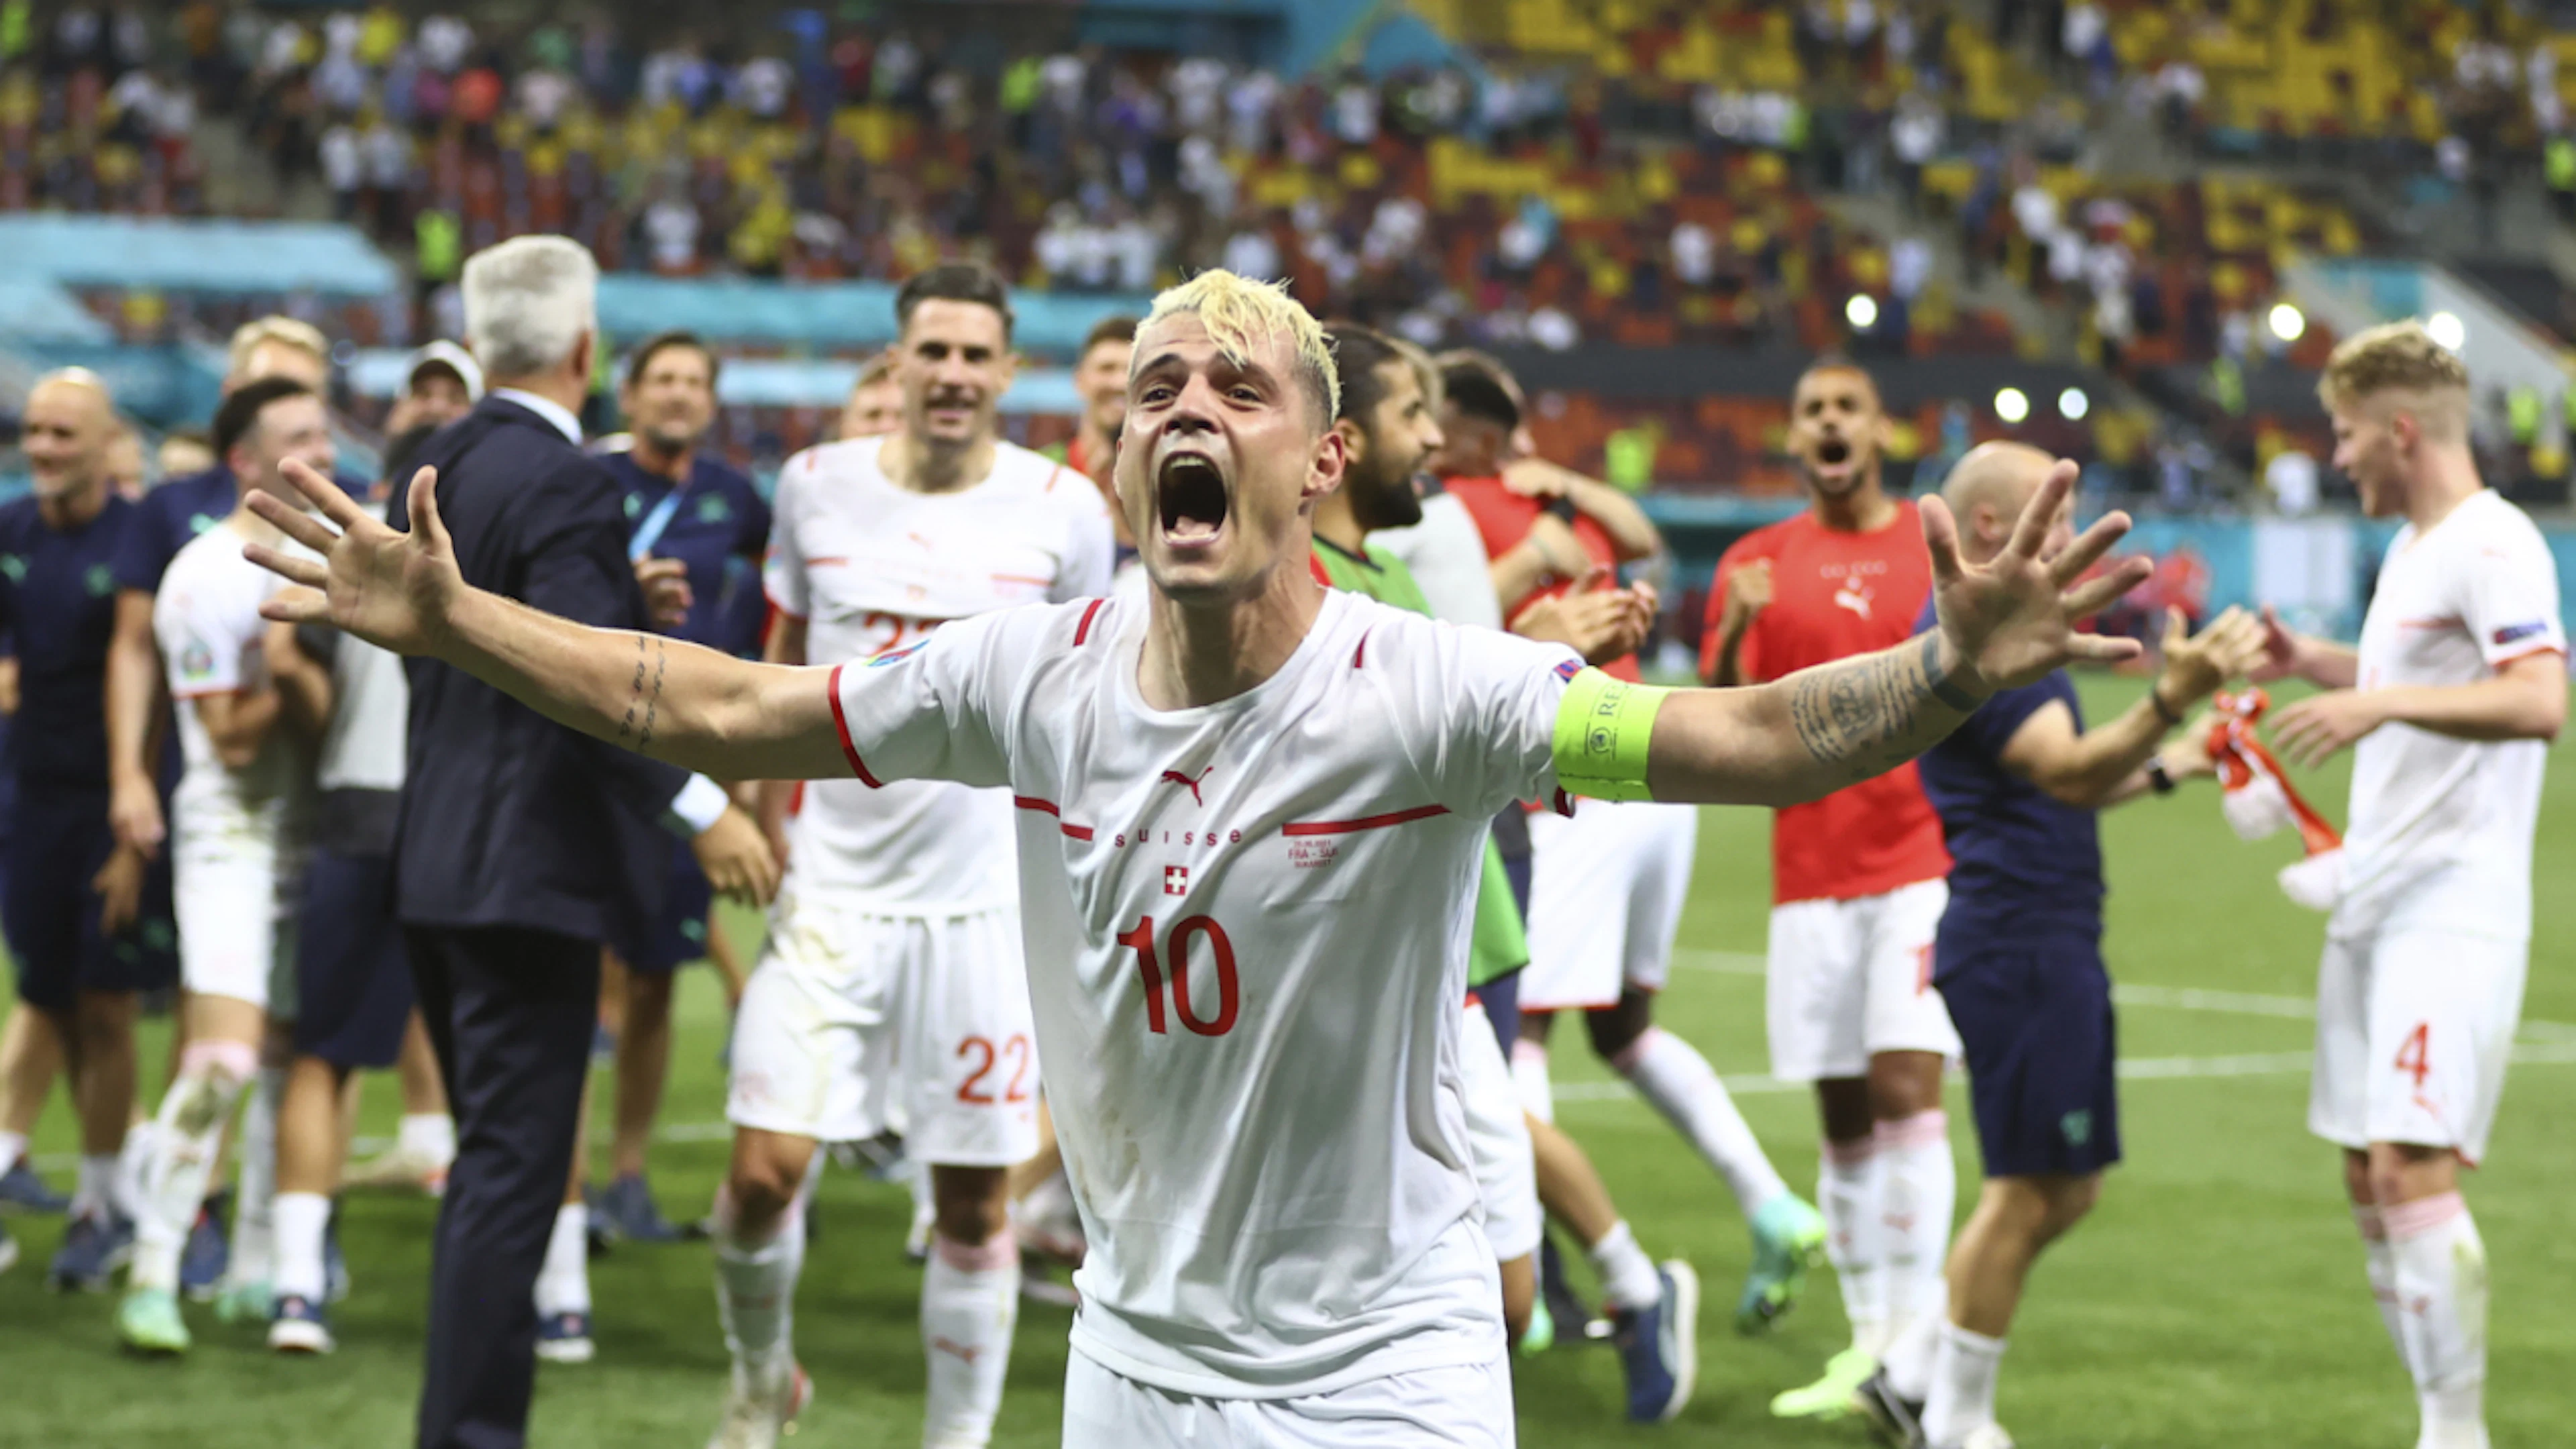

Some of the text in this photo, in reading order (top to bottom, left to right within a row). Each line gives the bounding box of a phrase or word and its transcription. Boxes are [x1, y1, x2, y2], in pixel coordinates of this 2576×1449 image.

[863, 610, 945, 657] 2
[1114, 828, 1241, 848] suisse
[1117, 914, 1238, 1037] 10
[955, 1033, 1030, 1105] 22
[2394, 1022, 2430, 1087] 4
